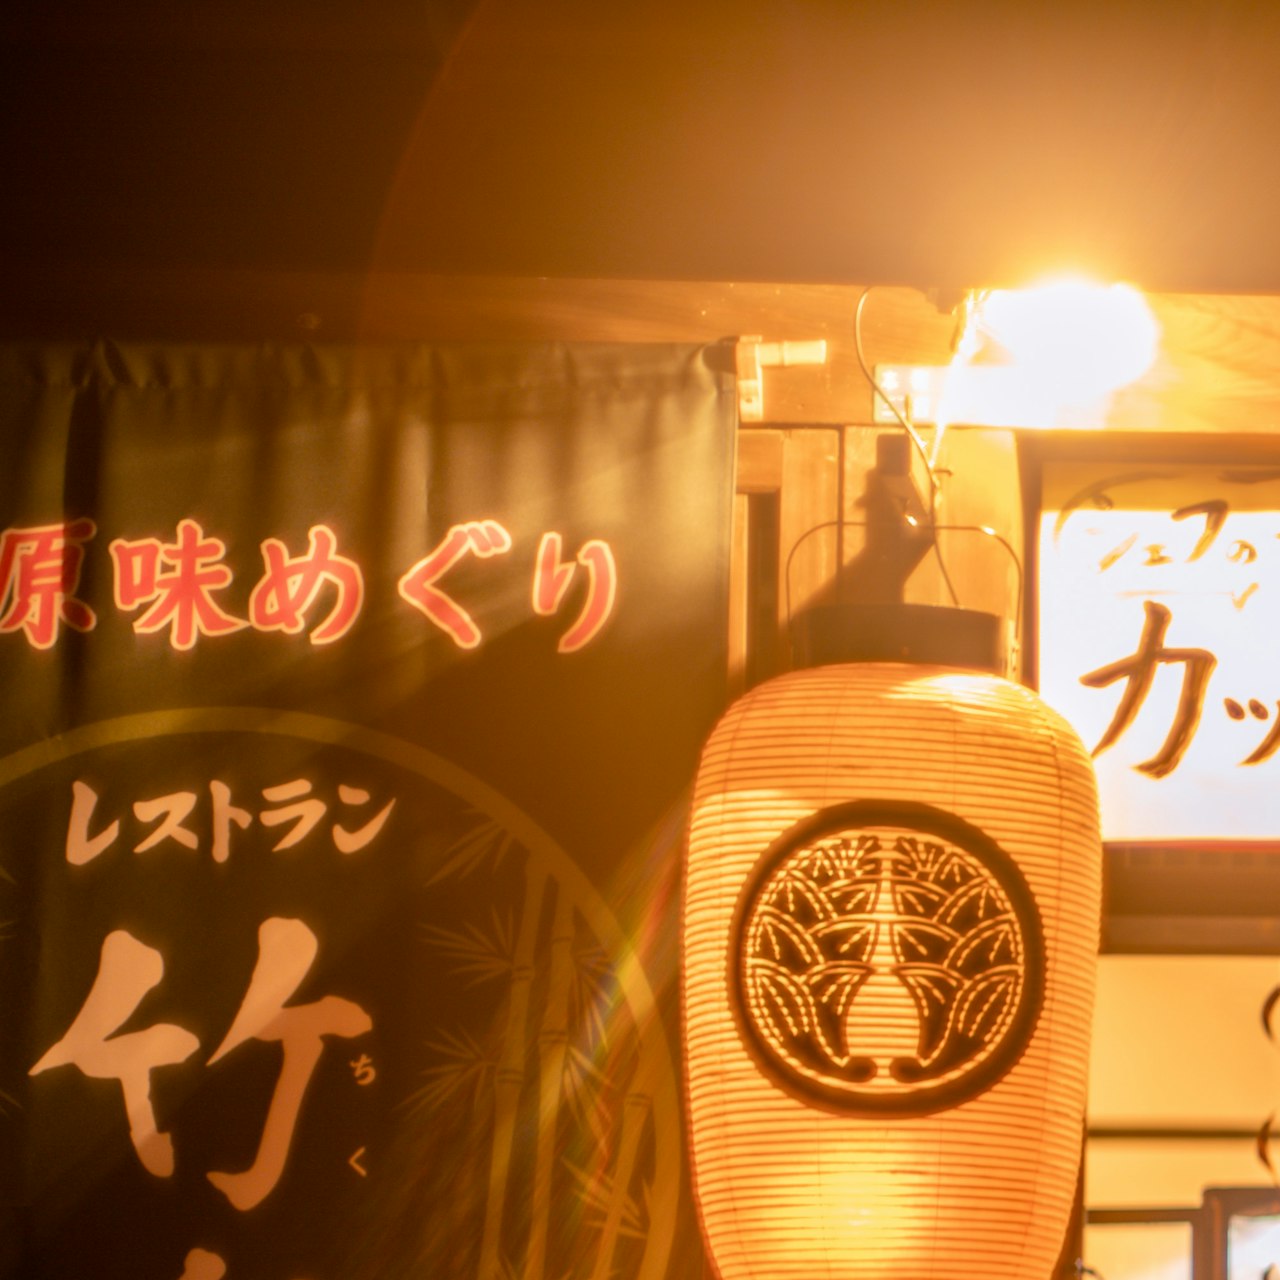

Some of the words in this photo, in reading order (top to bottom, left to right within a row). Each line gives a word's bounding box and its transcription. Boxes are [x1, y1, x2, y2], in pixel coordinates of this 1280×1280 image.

[0, 518, 618, 656] 原味めぐり
[65, 778, 398, 867] レストラン
